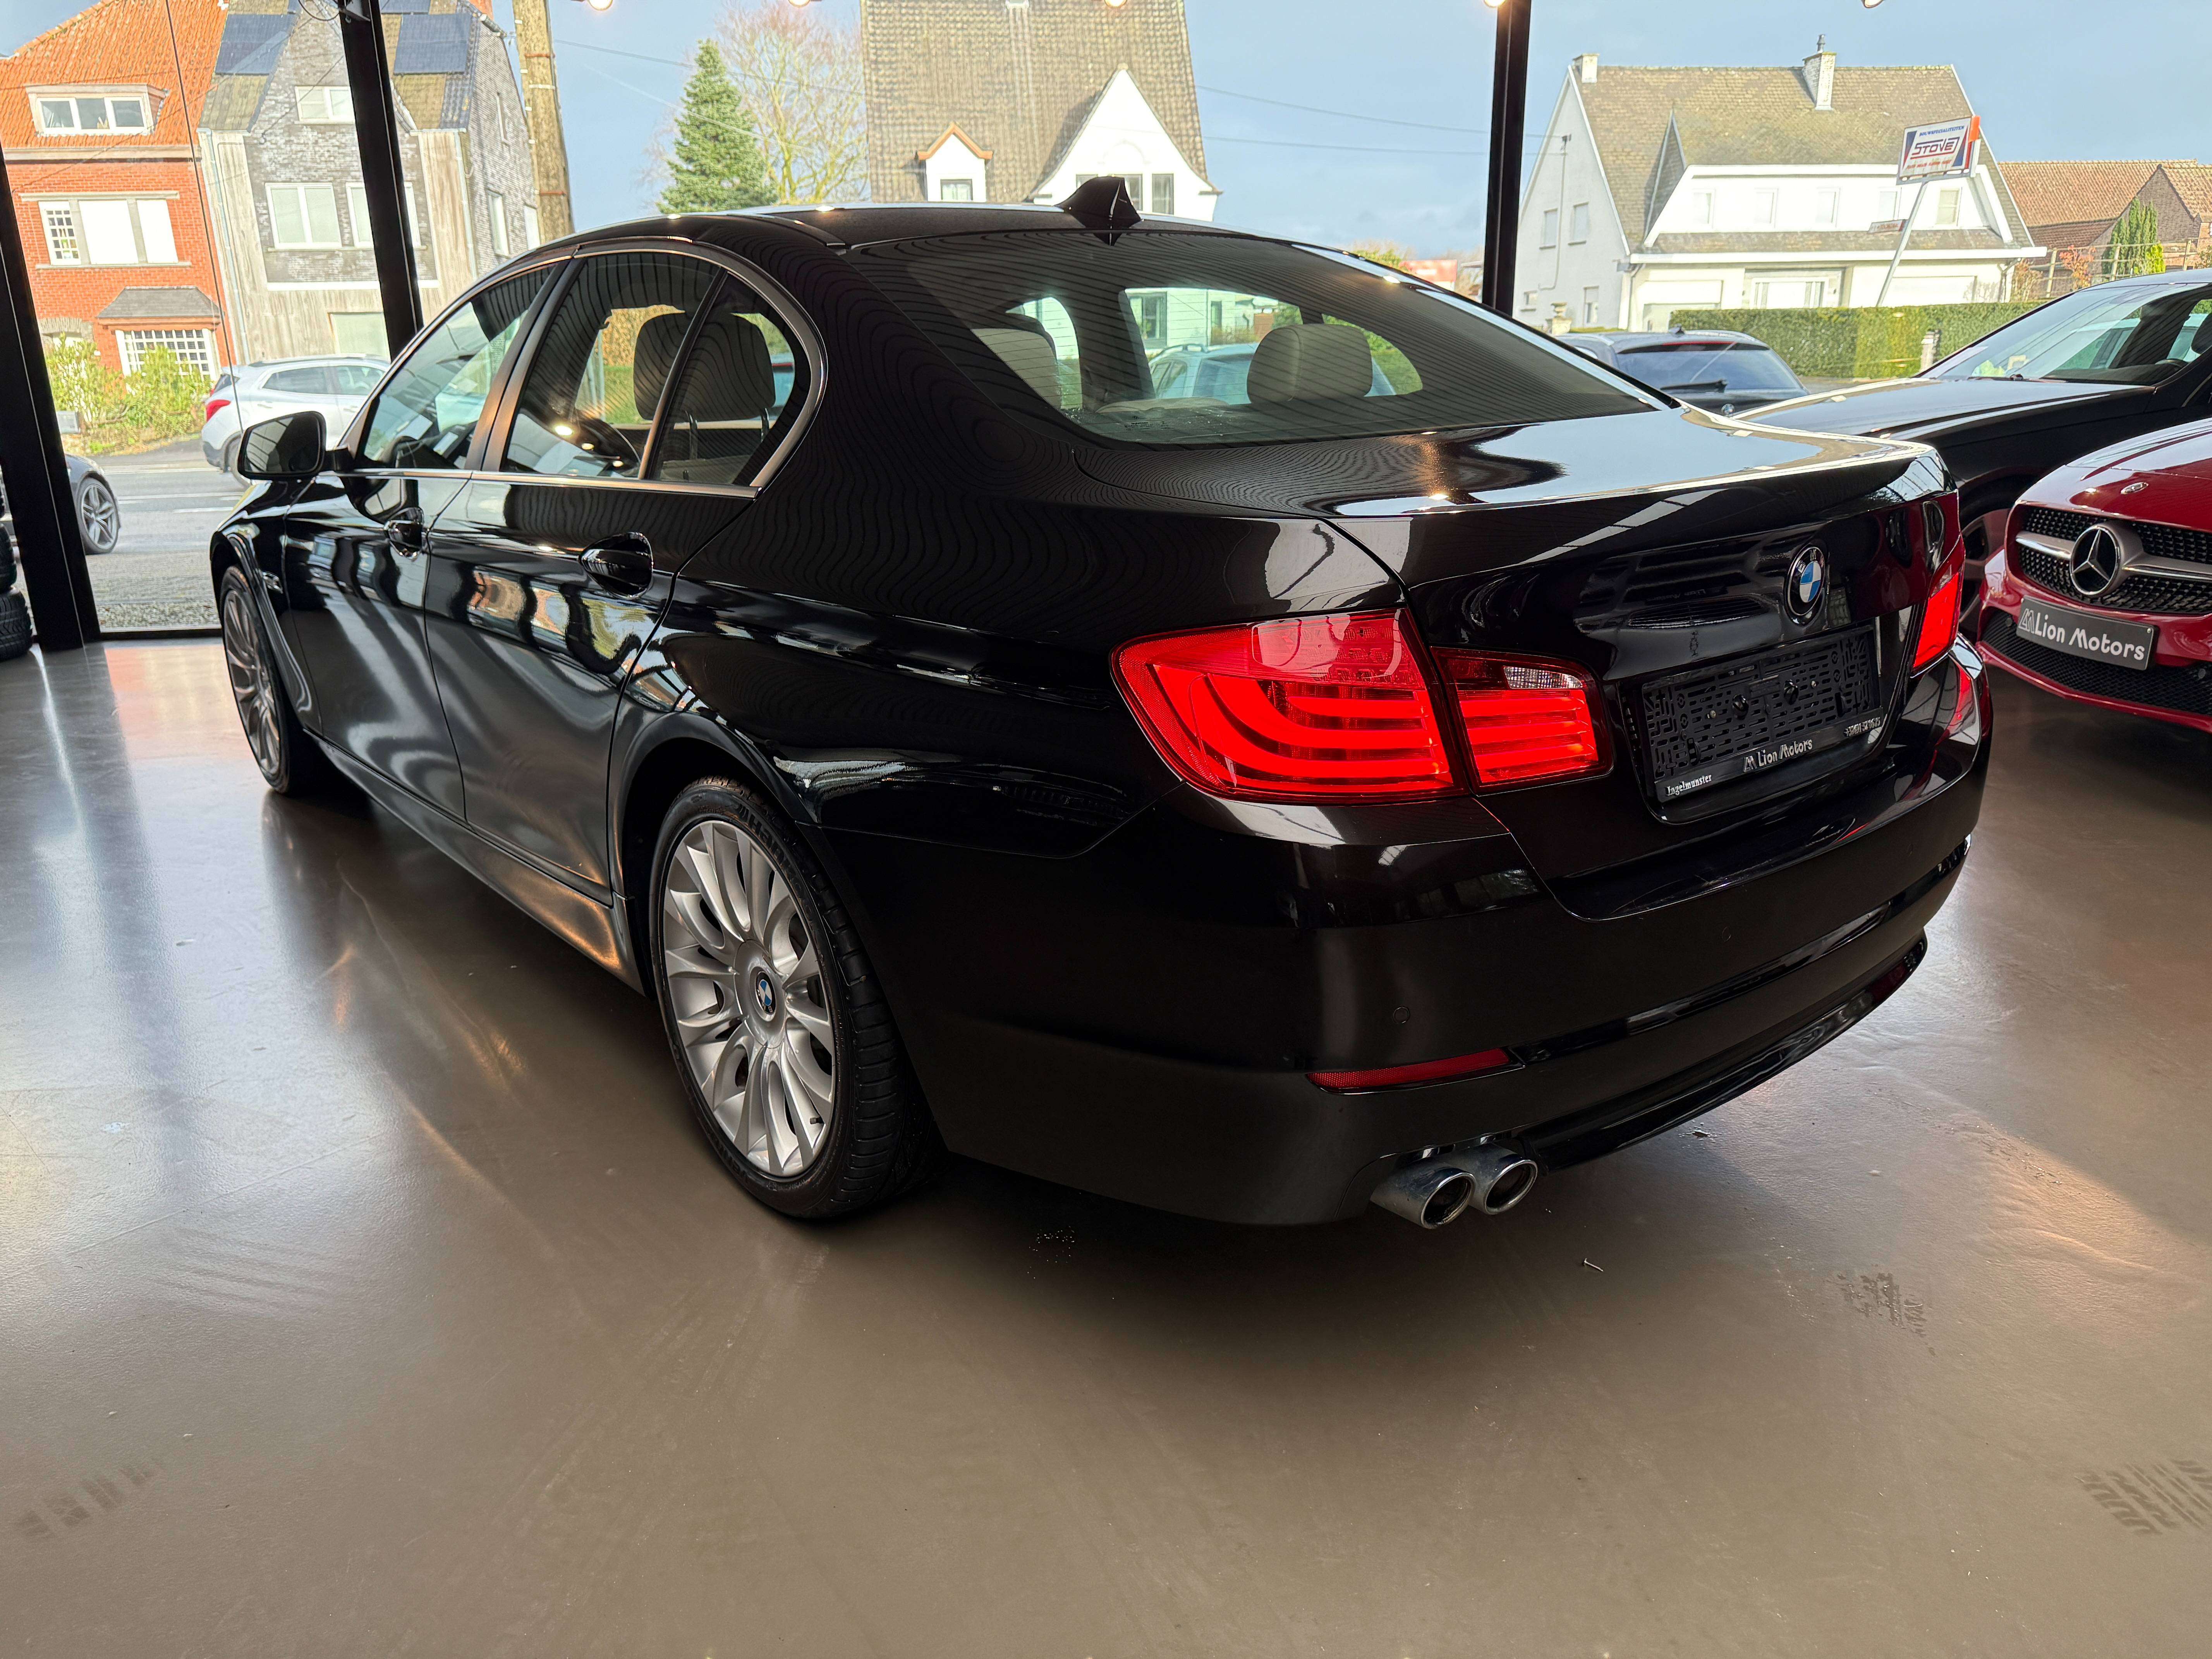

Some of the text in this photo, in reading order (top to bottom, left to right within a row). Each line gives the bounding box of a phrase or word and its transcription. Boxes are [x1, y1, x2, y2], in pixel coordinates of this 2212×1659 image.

[1912, 137, 1960, 156] STOVE
[2035, 612, 2145, 660] Lion Motors
[1756, 739, 1813, 767] Lion Motors
[1666, 774, 1712, 796] Ingelmunster
